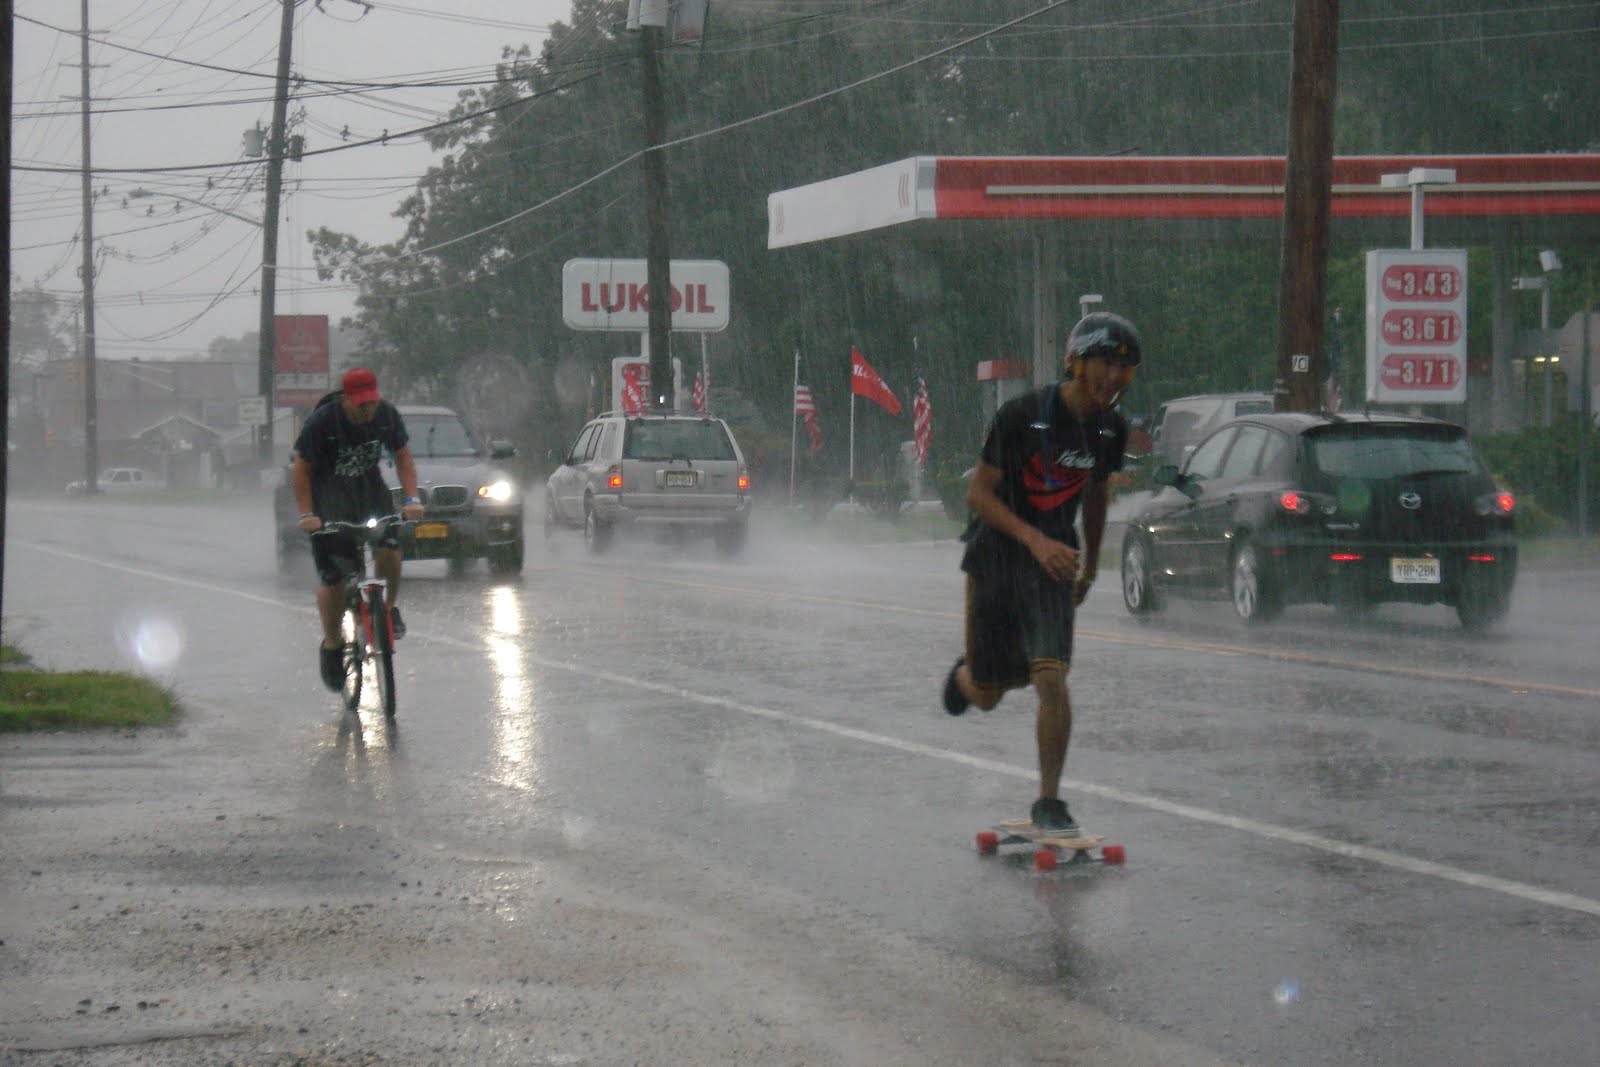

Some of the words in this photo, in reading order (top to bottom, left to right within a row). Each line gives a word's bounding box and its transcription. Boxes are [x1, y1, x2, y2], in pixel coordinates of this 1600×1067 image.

[1403, 271, 1452, 296] 3.43
[1402, 317, 1449, 340] 3.61
[1402, 360, 1449, 384] 3.71
